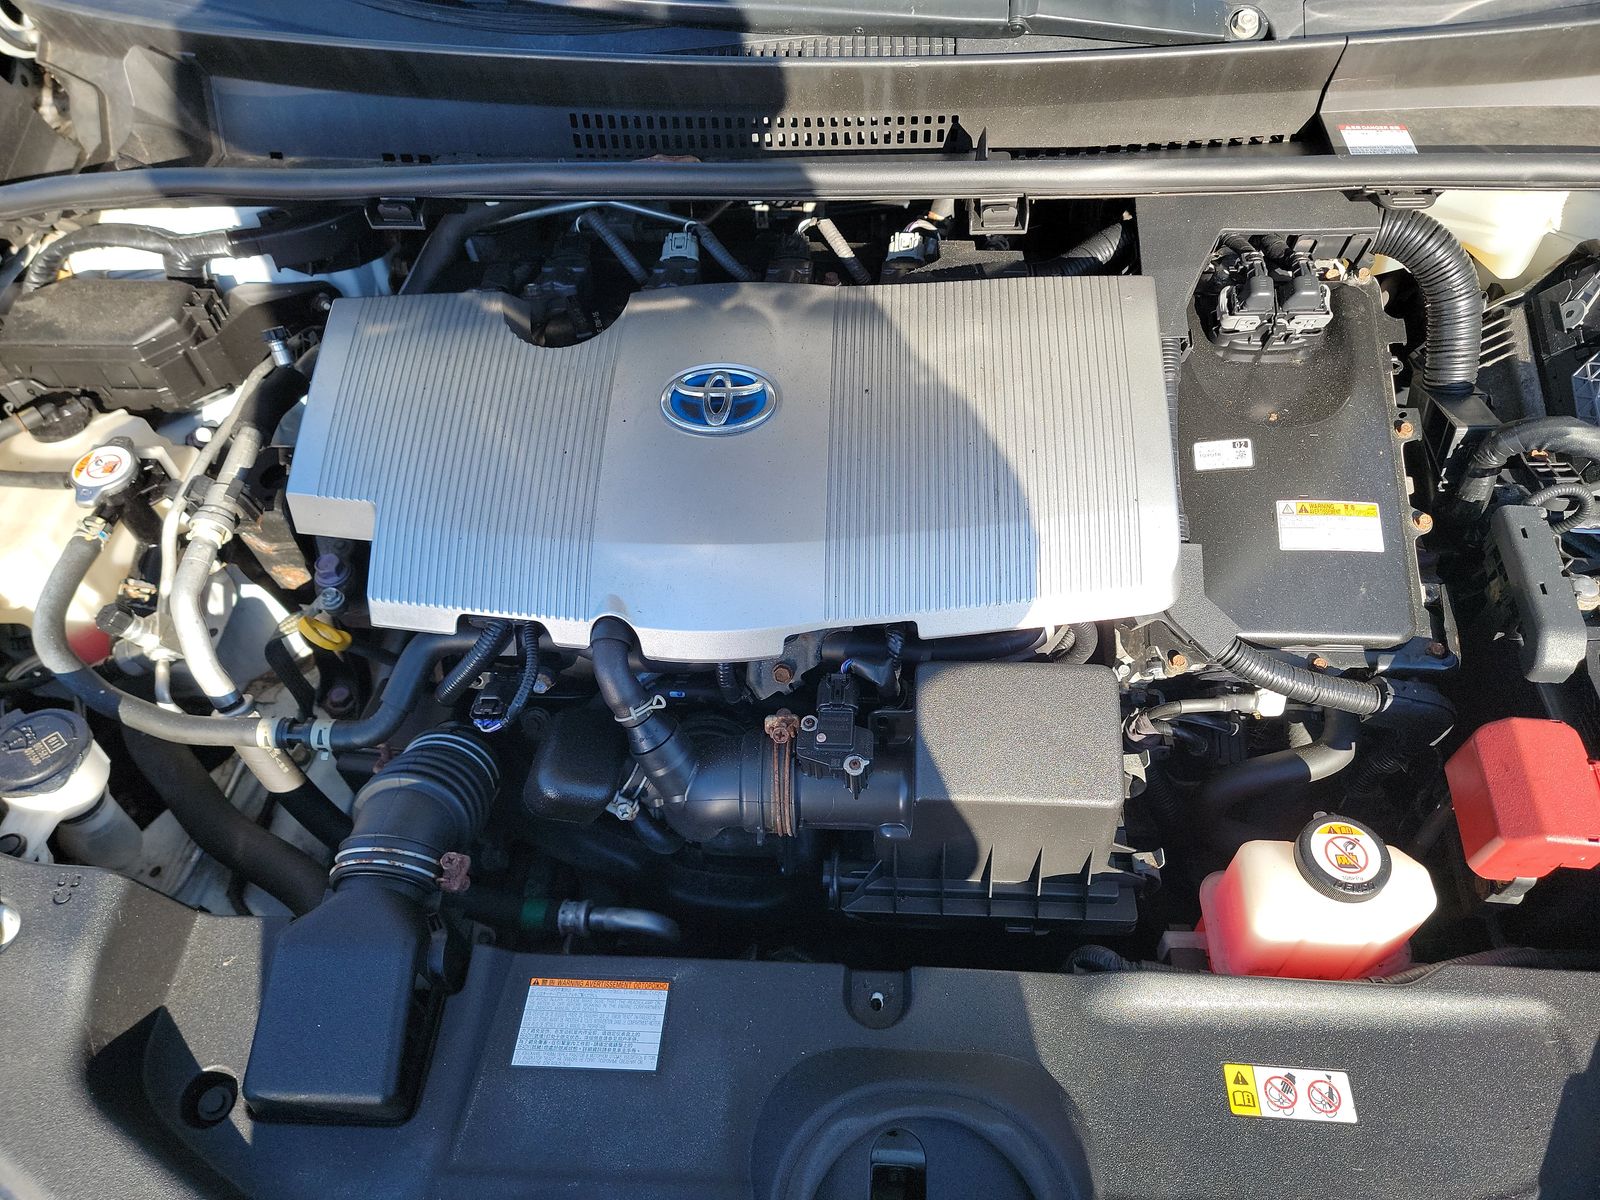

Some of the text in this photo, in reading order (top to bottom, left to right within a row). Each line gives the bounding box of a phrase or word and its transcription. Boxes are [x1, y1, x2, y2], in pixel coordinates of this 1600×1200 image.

[1332, 880, 1376, 893] DENSO
[558, 979, 583, 987] WARNING
[585, 980, 630, 989] AVERTISSEMENT
